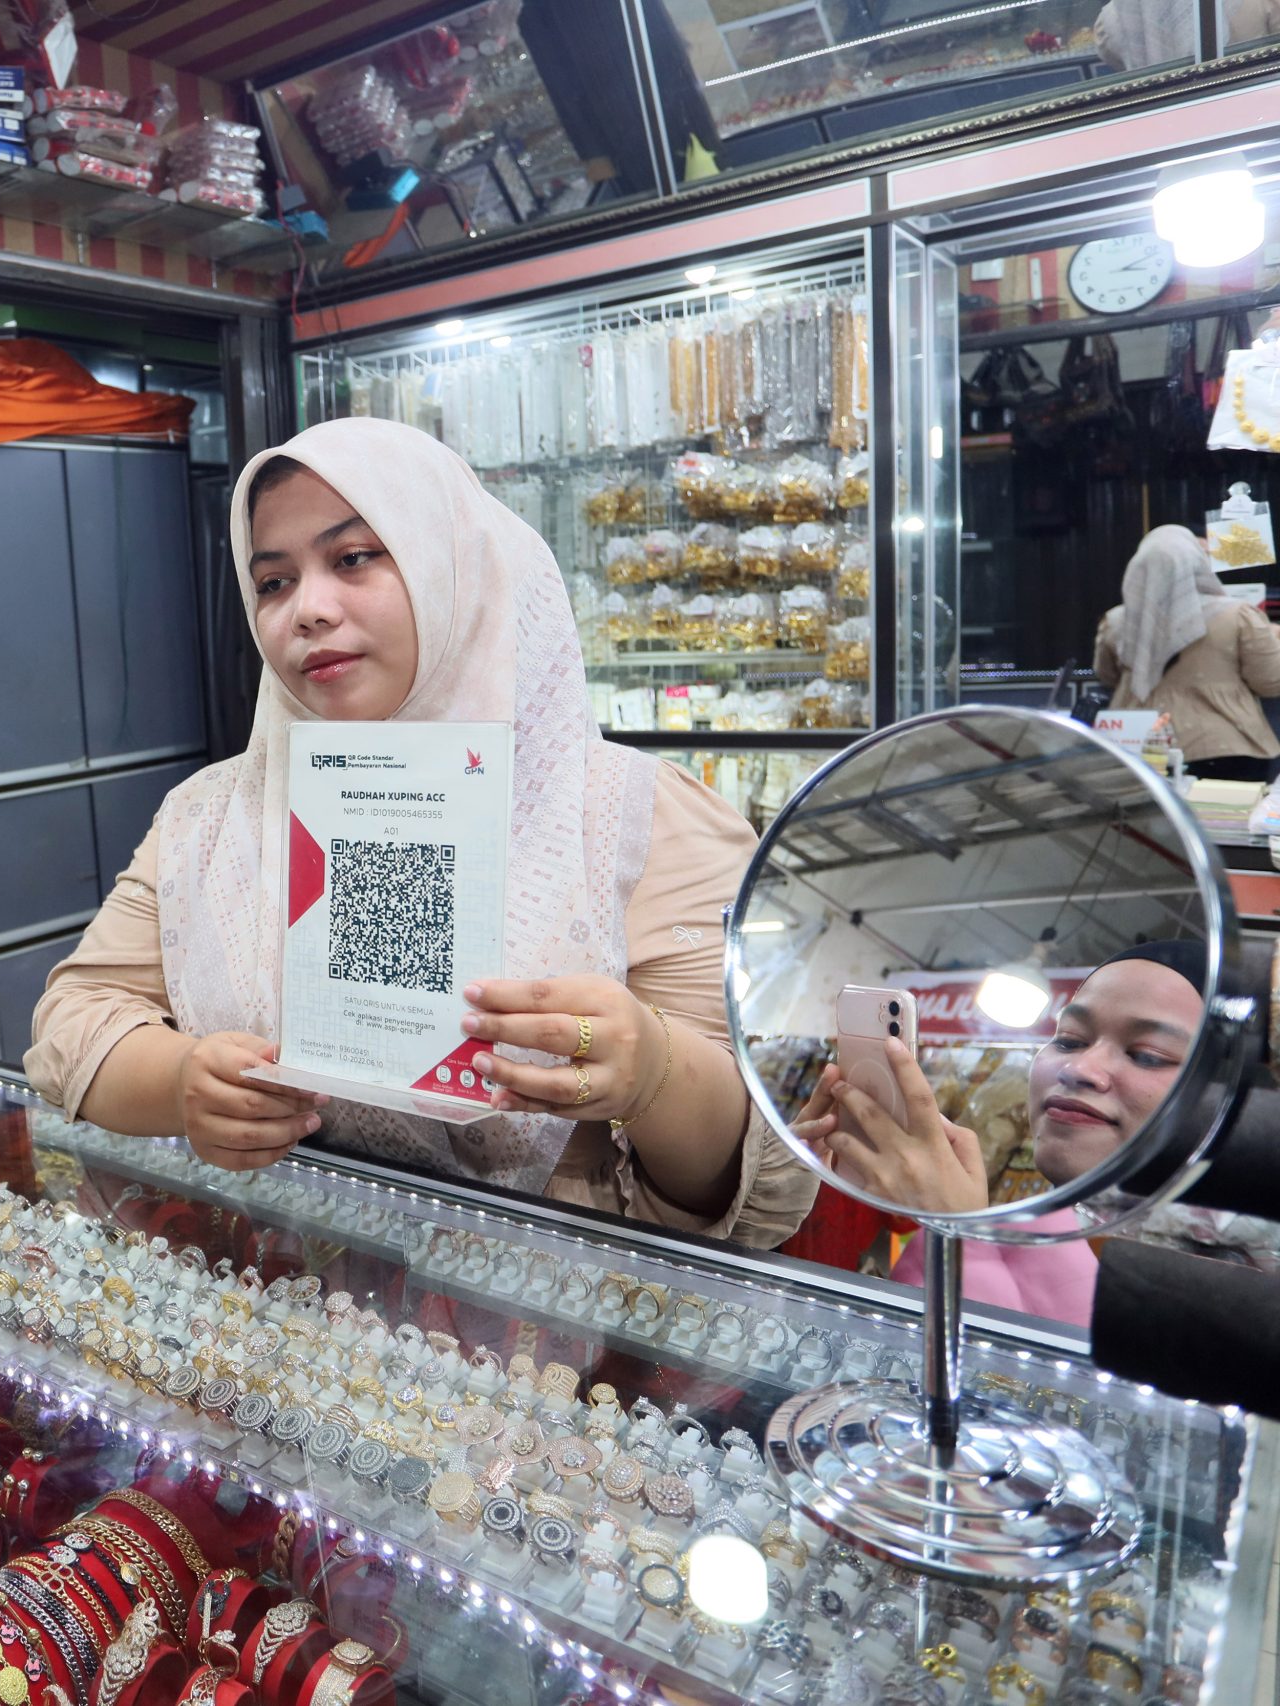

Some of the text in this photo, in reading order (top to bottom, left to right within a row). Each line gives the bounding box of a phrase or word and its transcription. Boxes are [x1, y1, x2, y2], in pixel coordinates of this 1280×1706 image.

[311, 753, 347, 770] QRIS
[347, 762, 382, 770] Pembayaran
[464, 766, 485, 775] GPN
[341, 791, 446, 802] RAUDHAH XUPING ACC
[343, 807, 365, 816] NMID
[370, 808, 443, 819] ID1019005465355
[383, 827, 399, 836] A01
[344, 996, 434, 1016] SATU QRIS UNTUK SEMUA
[343, 1009, 436, 1031] Cek aplikasi penyelenggara
[355, 1019, 422, 1036] di: www.aspi-qris.id
[322, 1042, 336, 1051] oleh
